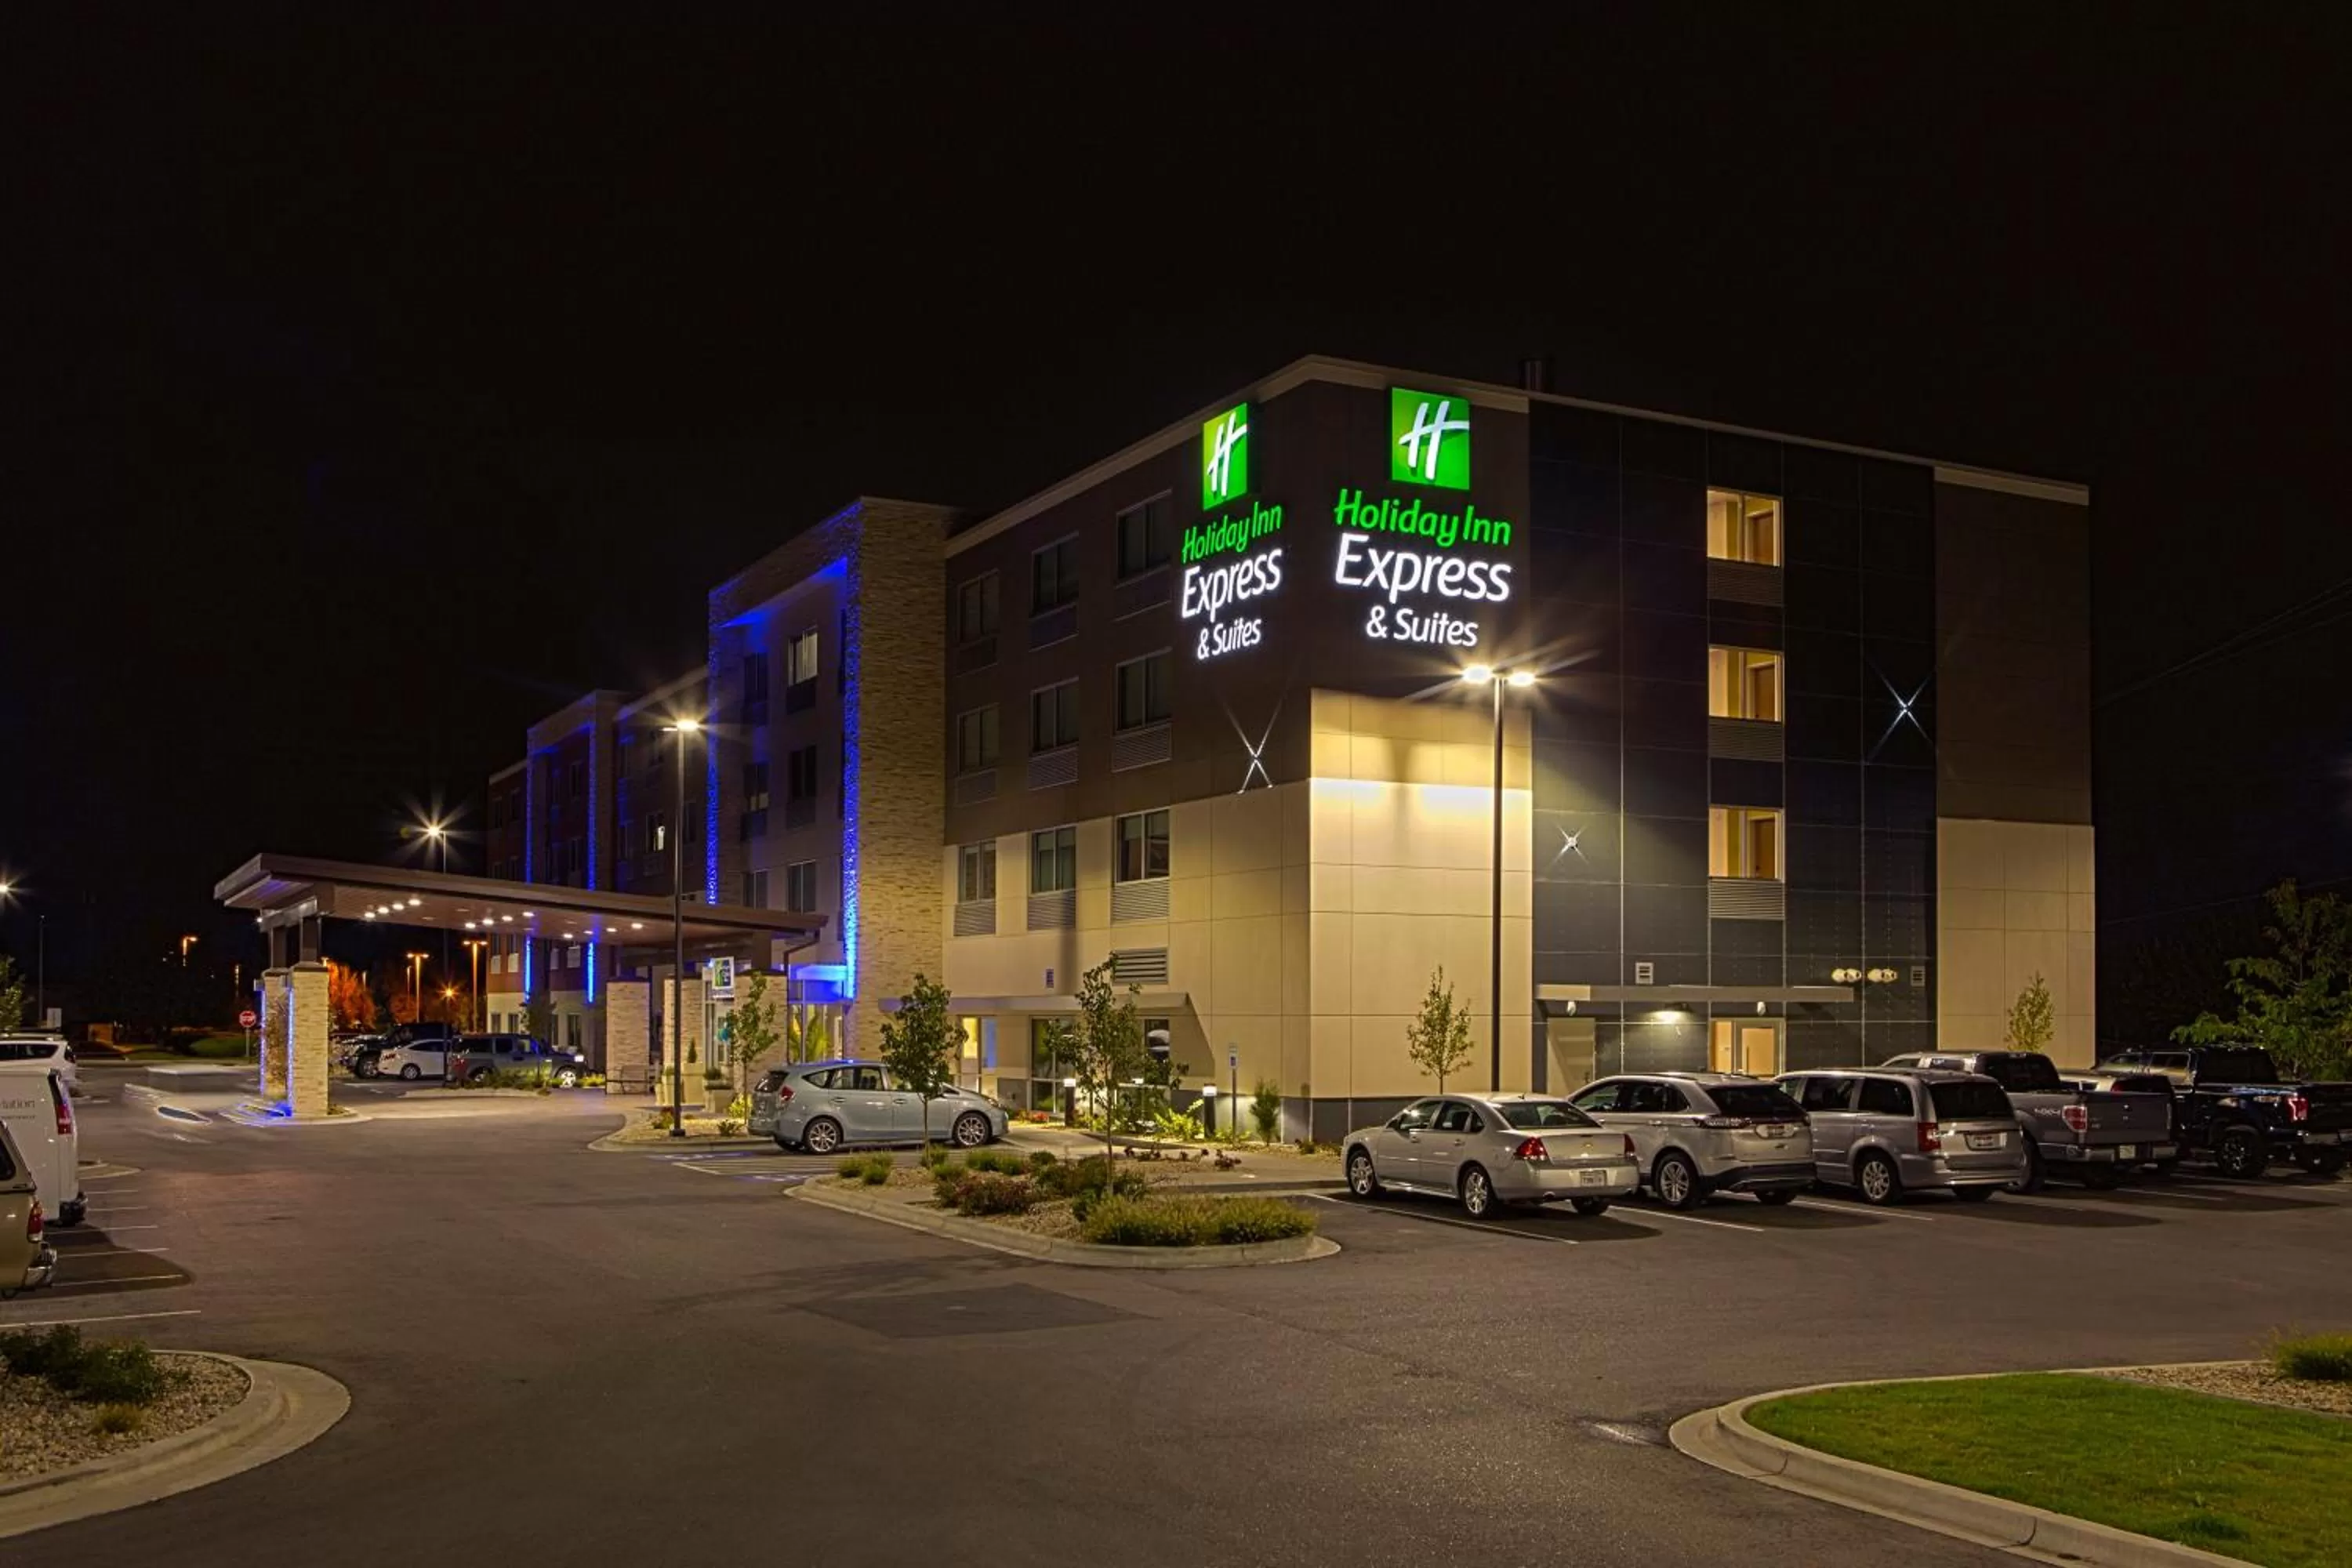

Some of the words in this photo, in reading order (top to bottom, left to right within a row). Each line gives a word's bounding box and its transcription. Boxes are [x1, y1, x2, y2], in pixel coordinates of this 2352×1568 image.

[1182, 514, 1249, 564] Holiday
[1253, 502, 1282, 538] Inn
[1334, 488, 1459, 547] Holiday
[1464, 506, 1511, 545] Inn
[1181, 548, 1283, 622] Express
[1334, 532, 1512, 604] Express
[1197, 627, 1209, 660] &
[1211, 619, 1261, 655] Suites
[1366, 605, 1387, 638] &
[1393, 608, 1479, 646] Suites
